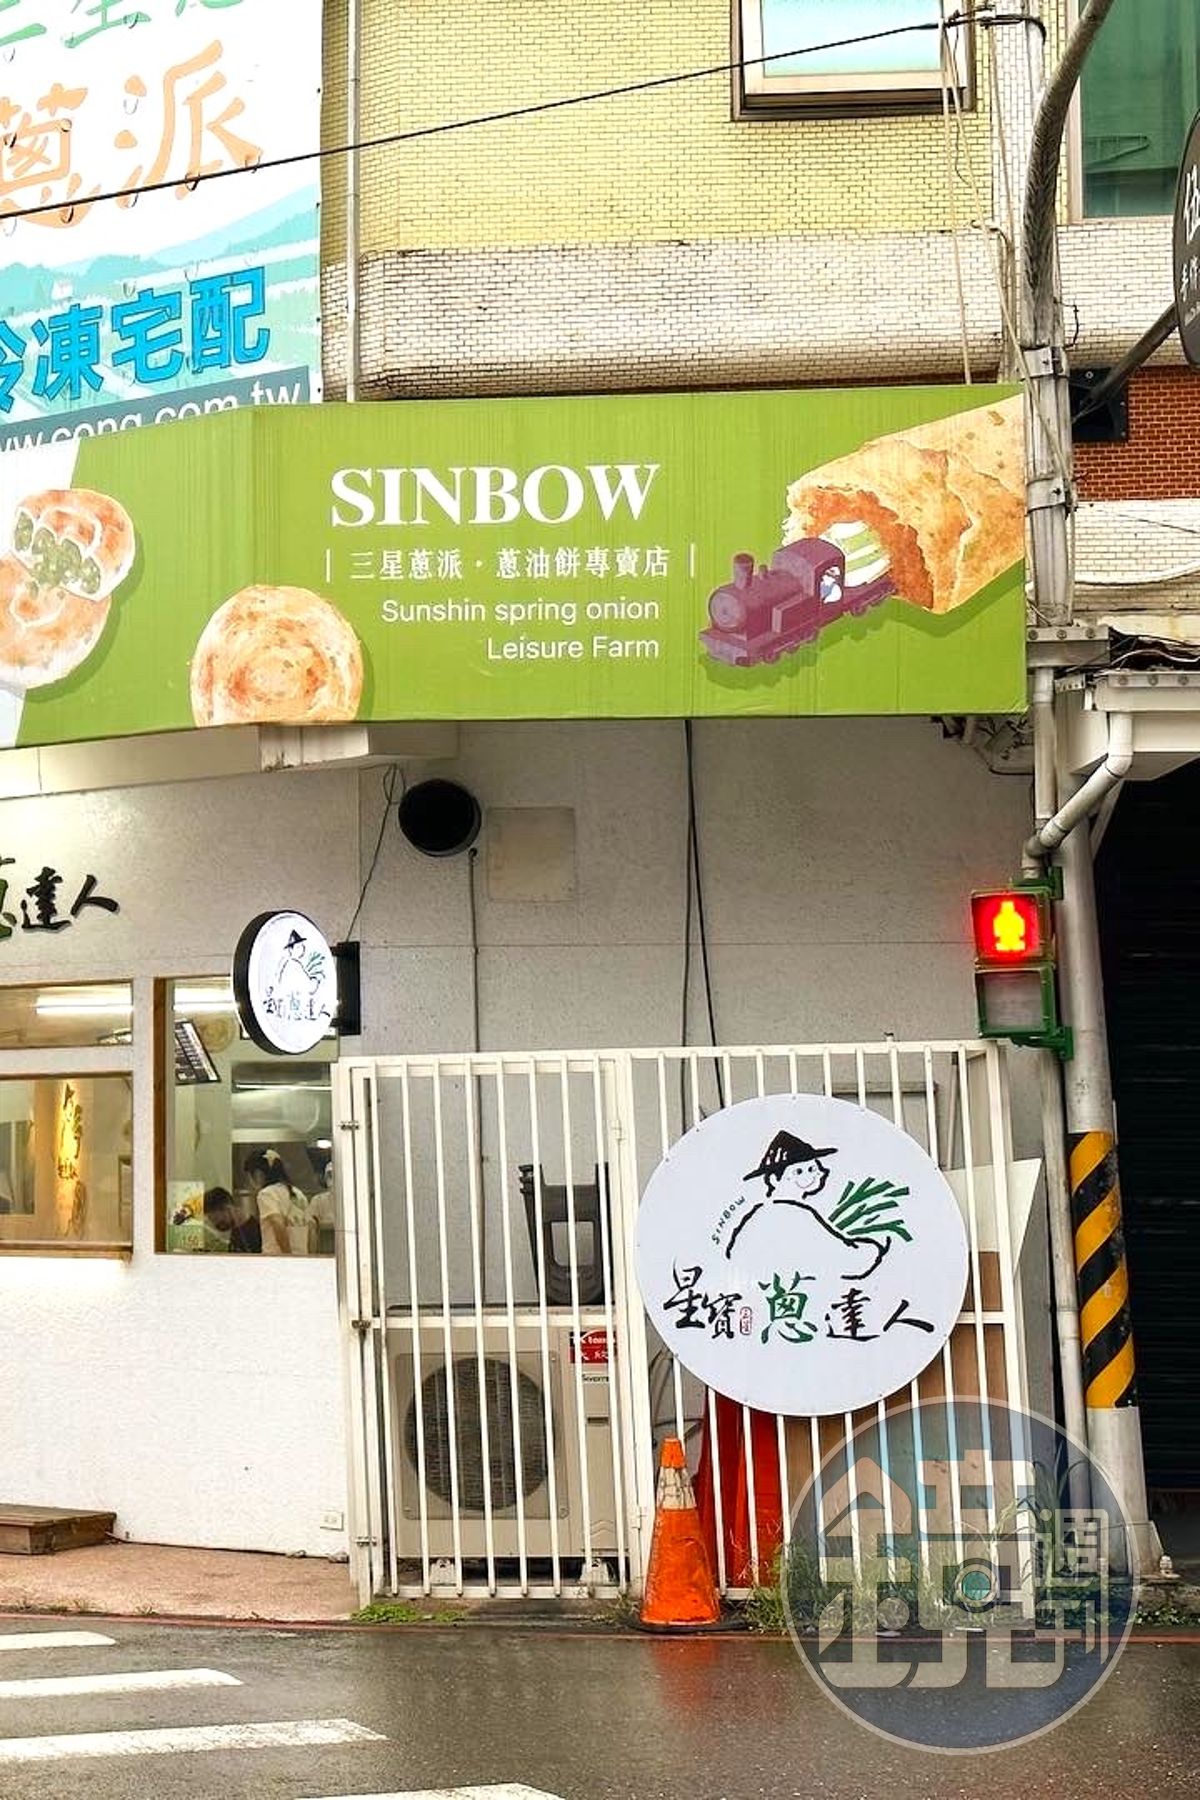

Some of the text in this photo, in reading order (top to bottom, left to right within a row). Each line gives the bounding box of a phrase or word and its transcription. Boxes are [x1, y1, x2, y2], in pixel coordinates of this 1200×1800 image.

[331, 463, 661, 527] SINBOW
[381, 597, 660, 627] Sunshin spring onion
[487, 635, 660, 661] Leisure Farm
[711, 1196, 746, 1245] SINBOW
